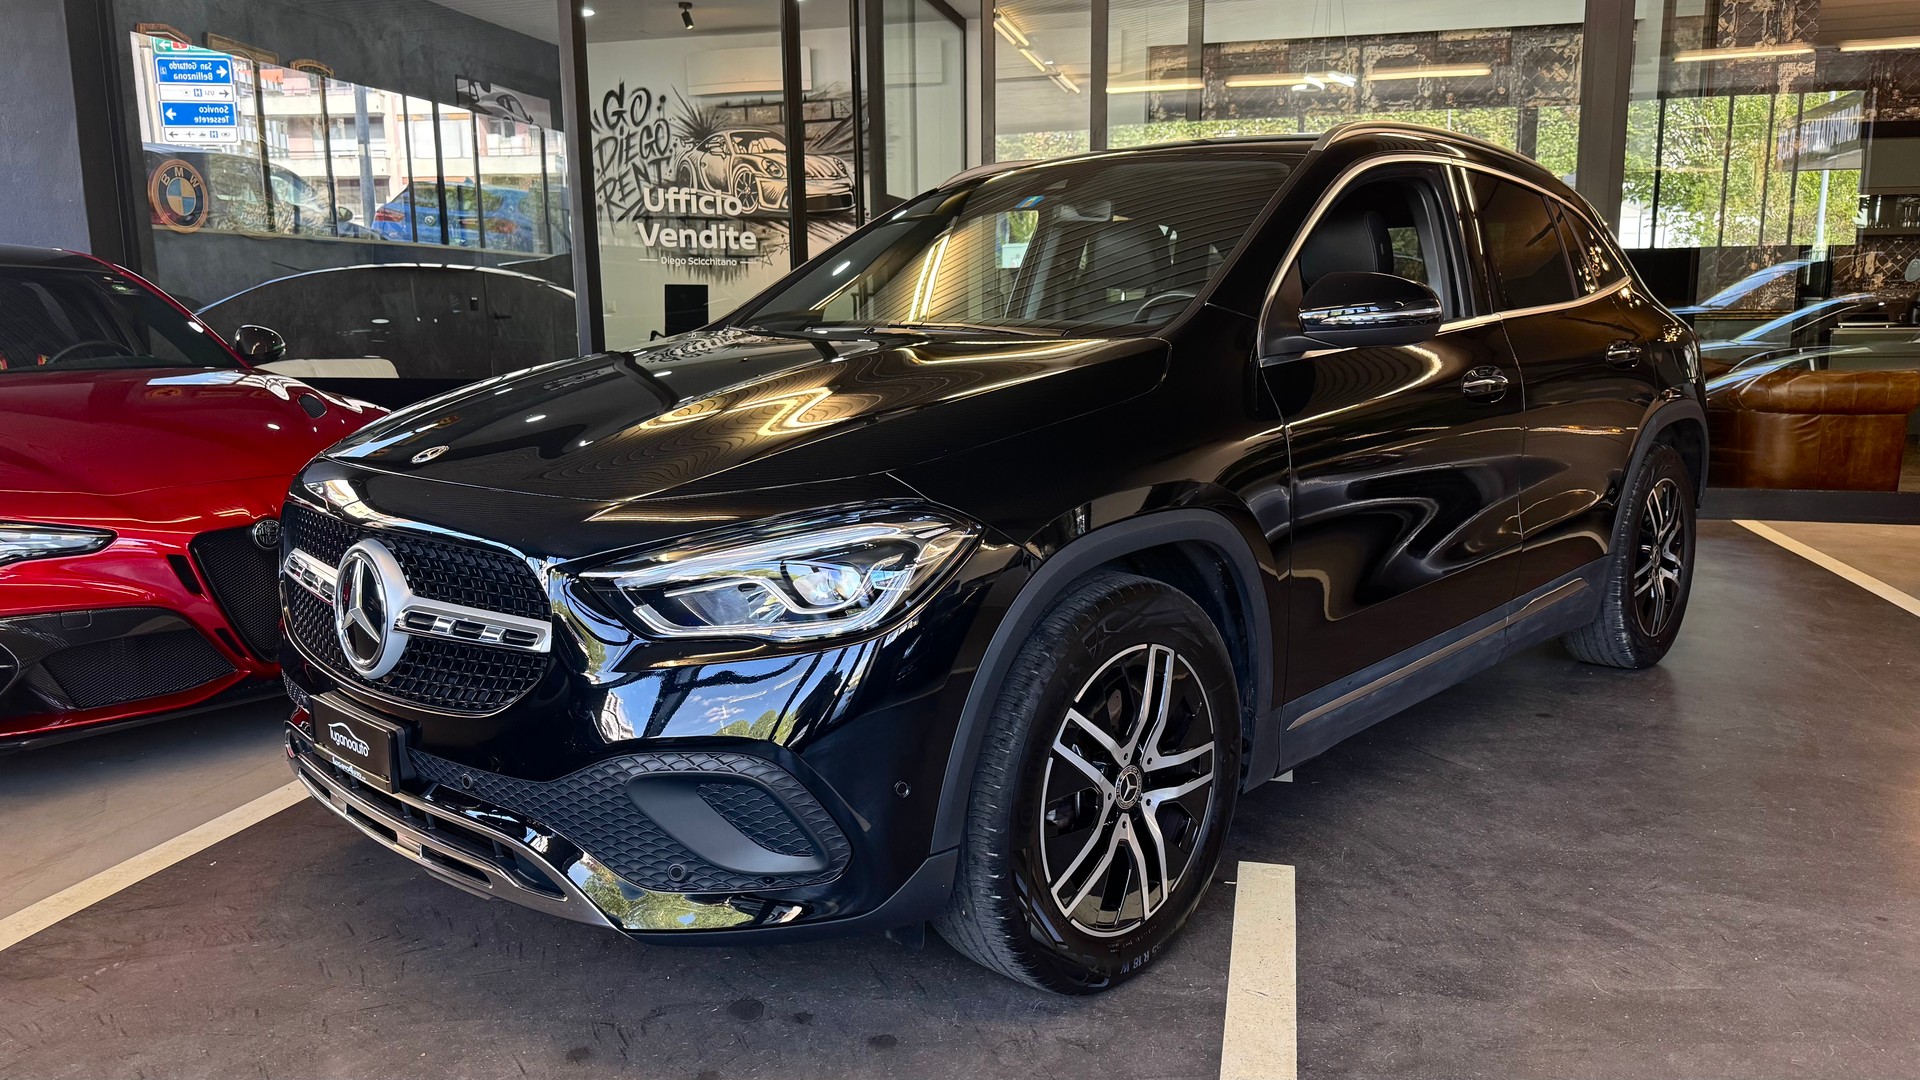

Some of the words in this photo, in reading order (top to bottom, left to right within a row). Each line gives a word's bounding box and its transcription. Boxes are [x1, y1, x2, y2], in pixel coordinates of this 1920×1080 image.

[603, 80, 652, 130] GO
[160, 167, 200, 188] BMW
[643, 186, 743, 216] Ufficio
[637, 222, 757, 250] Vendite
[661, 257, 686, 266] Diego
[688, 257, 737, 266] Scicchitano
